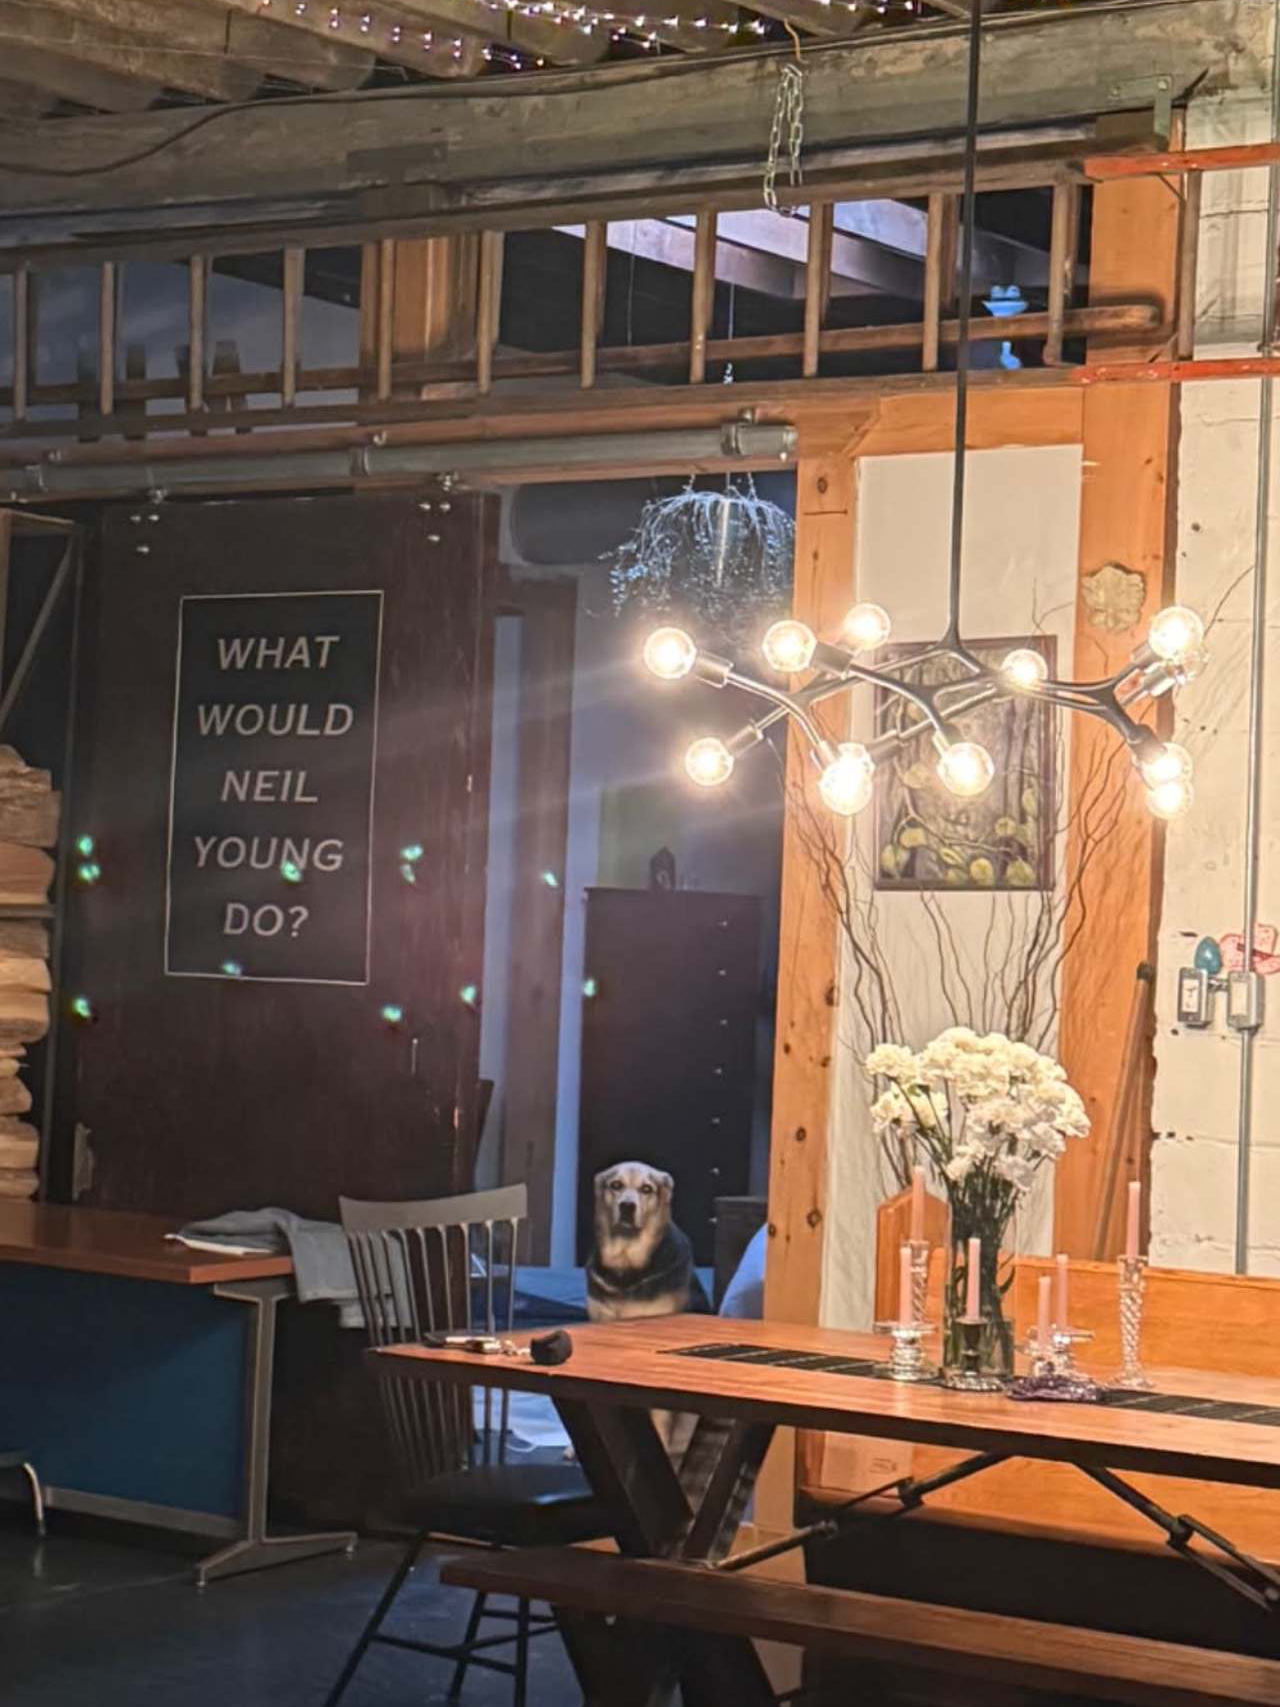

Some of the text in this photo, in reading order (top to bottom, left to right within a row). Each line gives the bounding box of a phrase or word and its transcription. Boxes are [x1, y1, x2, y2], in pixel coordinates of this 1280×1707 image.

[218, 636, 340, 670] WHAT
[197, 703, 354, 736] WOULD
[221, 770, 318, 803] NEIL
[194, 836, 344, 871] YOUNG
[223, 903, 310, 937] DO?
